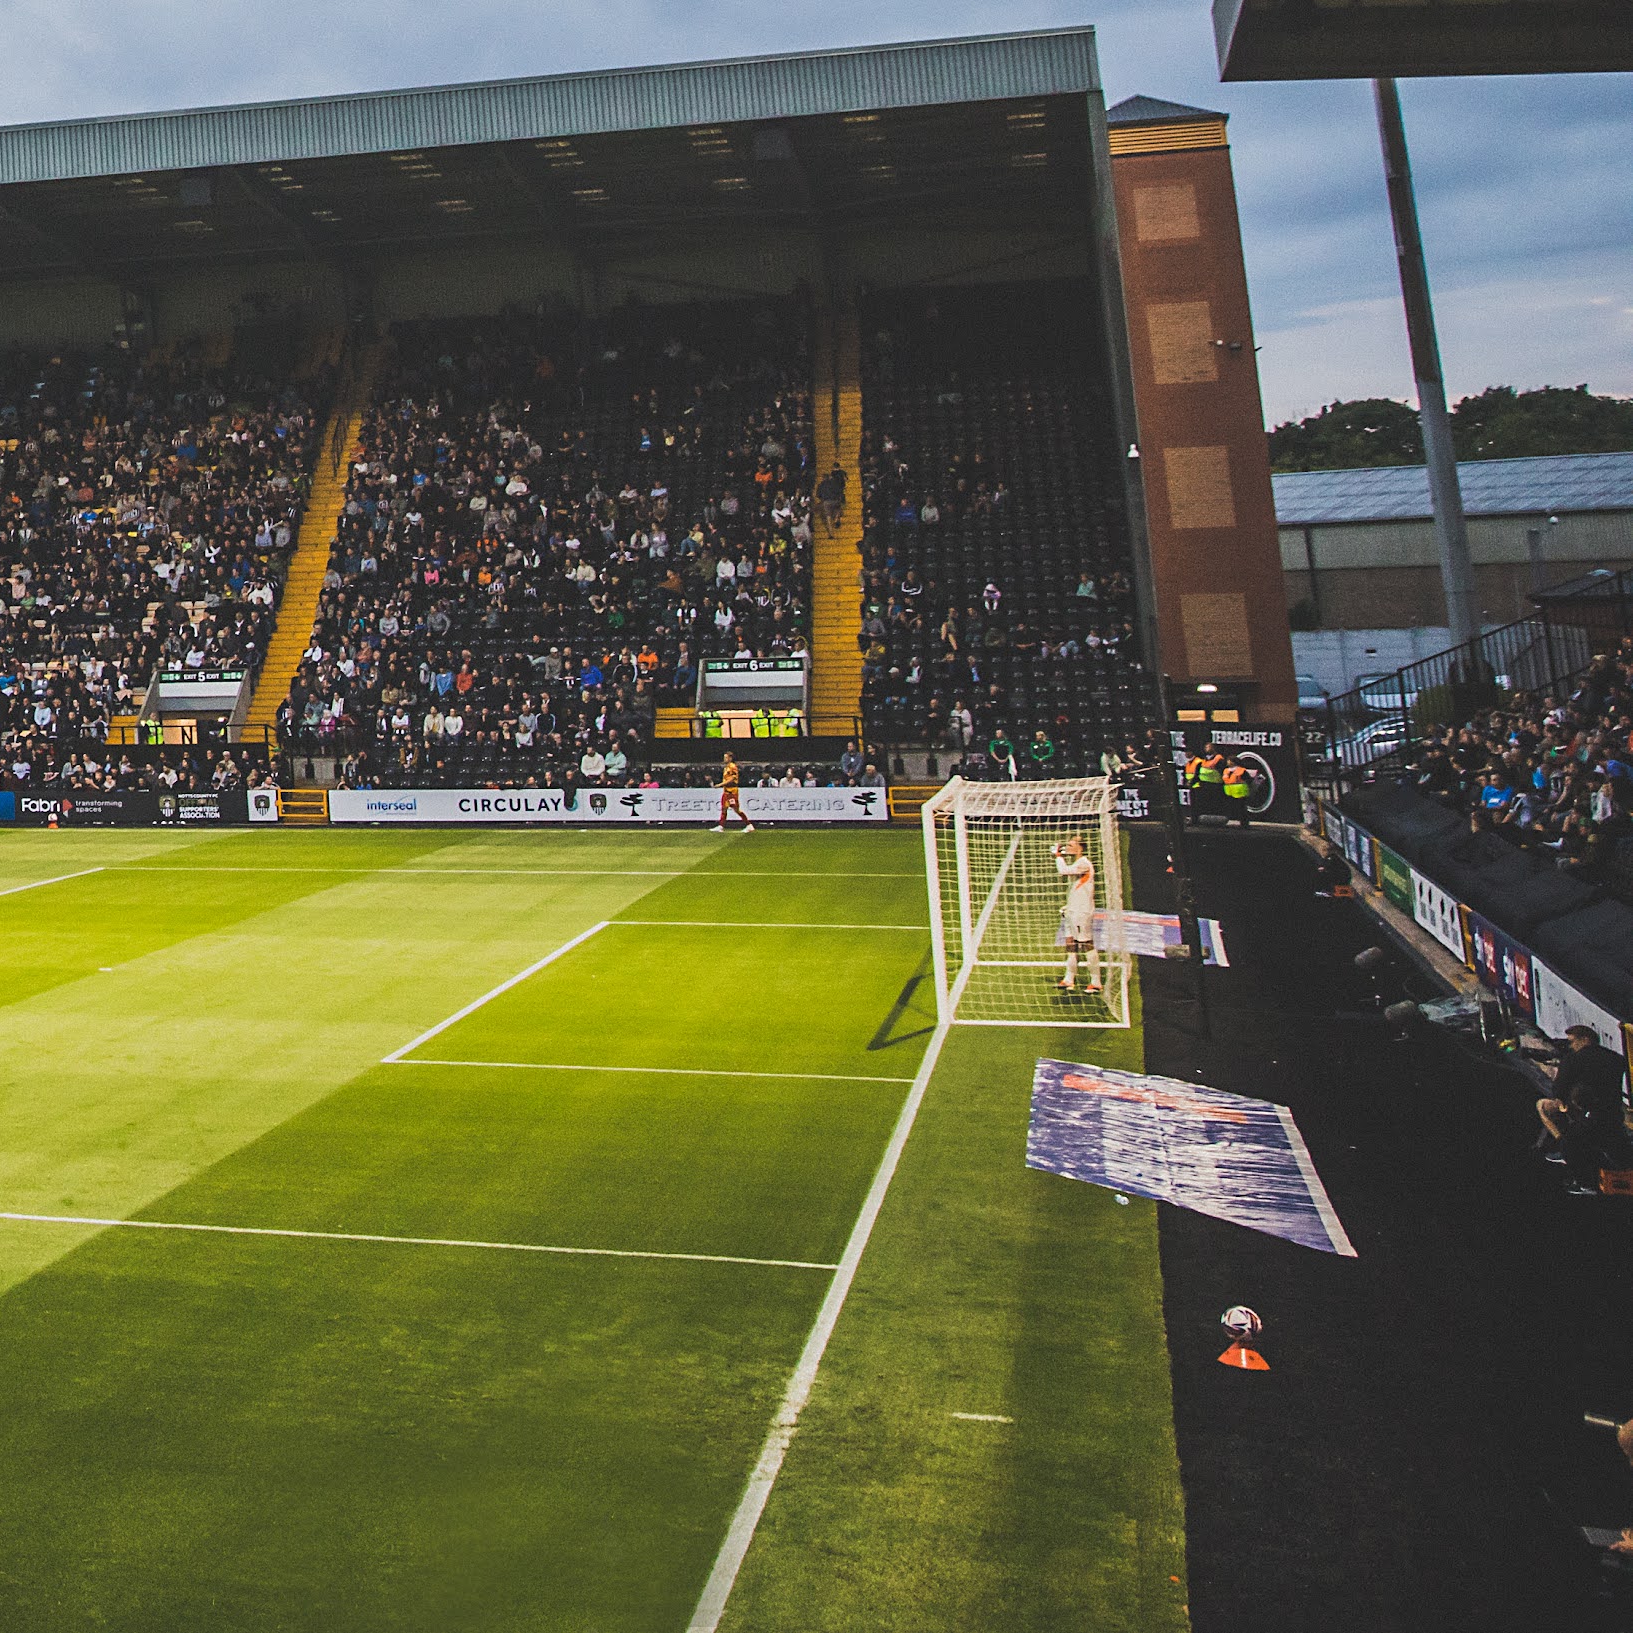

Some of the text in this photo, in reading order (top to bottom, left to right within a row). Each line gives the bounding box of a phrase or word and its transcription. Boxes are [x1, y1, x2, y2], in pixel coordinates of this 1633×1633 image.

[749, 659, 758, 671] 6
[198, 671, 206, 681] 5
[75, 800, 123, 808] transforming
[366, 798, 417, 811] interseal
[458, 798, 561, 812] CIRCULAY
[652, 797, 845, 812] TREETO CATERING
